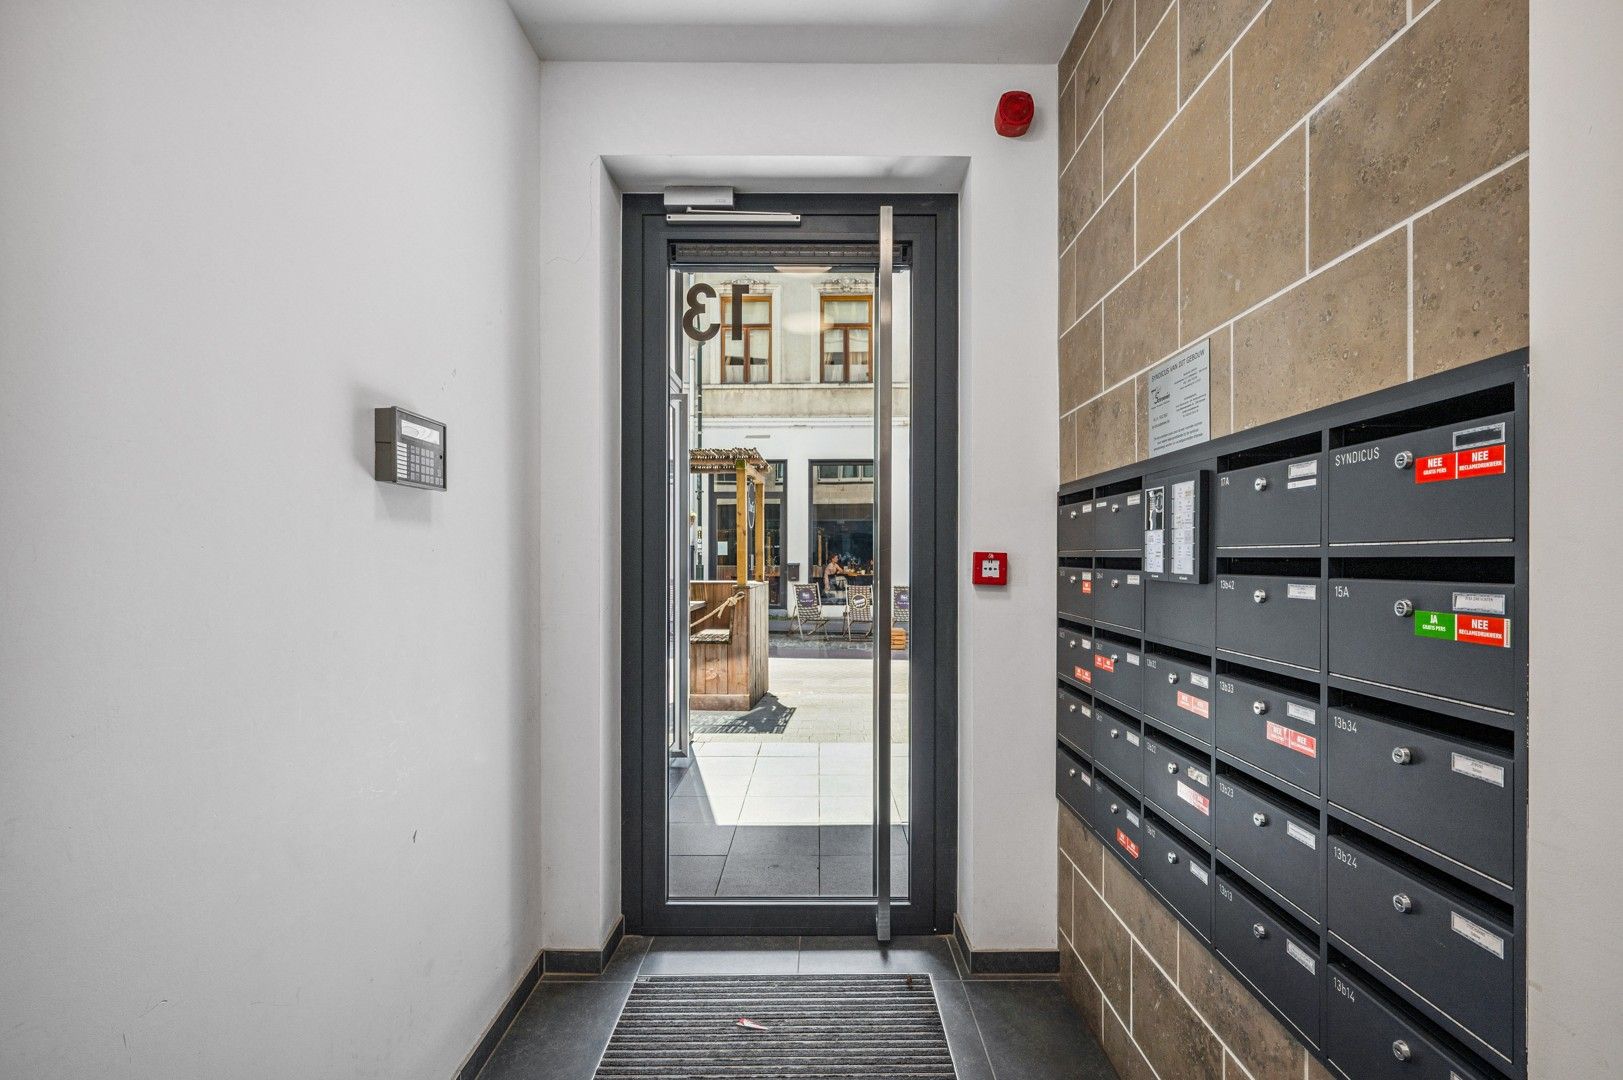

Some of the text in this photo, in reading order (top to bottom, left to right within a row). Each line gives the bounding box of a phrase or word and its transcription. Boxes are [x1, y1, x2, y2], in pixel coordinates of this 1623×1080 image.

[1335, 447, 1380, 467] SYNDICUS
[1471, 450, 1489, 462] NEE
[1427, 457, 1443, 468] NEE
[1459, 460, 1503, 472] RECLAMEDRUKWERK
[1335, 586, 1350, 598] 15A
[1430, 614, 1438, 625] JA
[1471, 618, 1489, 631] NEE
[1422, 624, 1446, 633] GRATIS PERS
[1458, 628, 1503, 640] RECLAMEDRUKWERK
[1333, 716, 1357, 734] 13b34
[1333, 846, 1358, 869] 13b24
[1333, 976, 1355, 1003] 13b14
